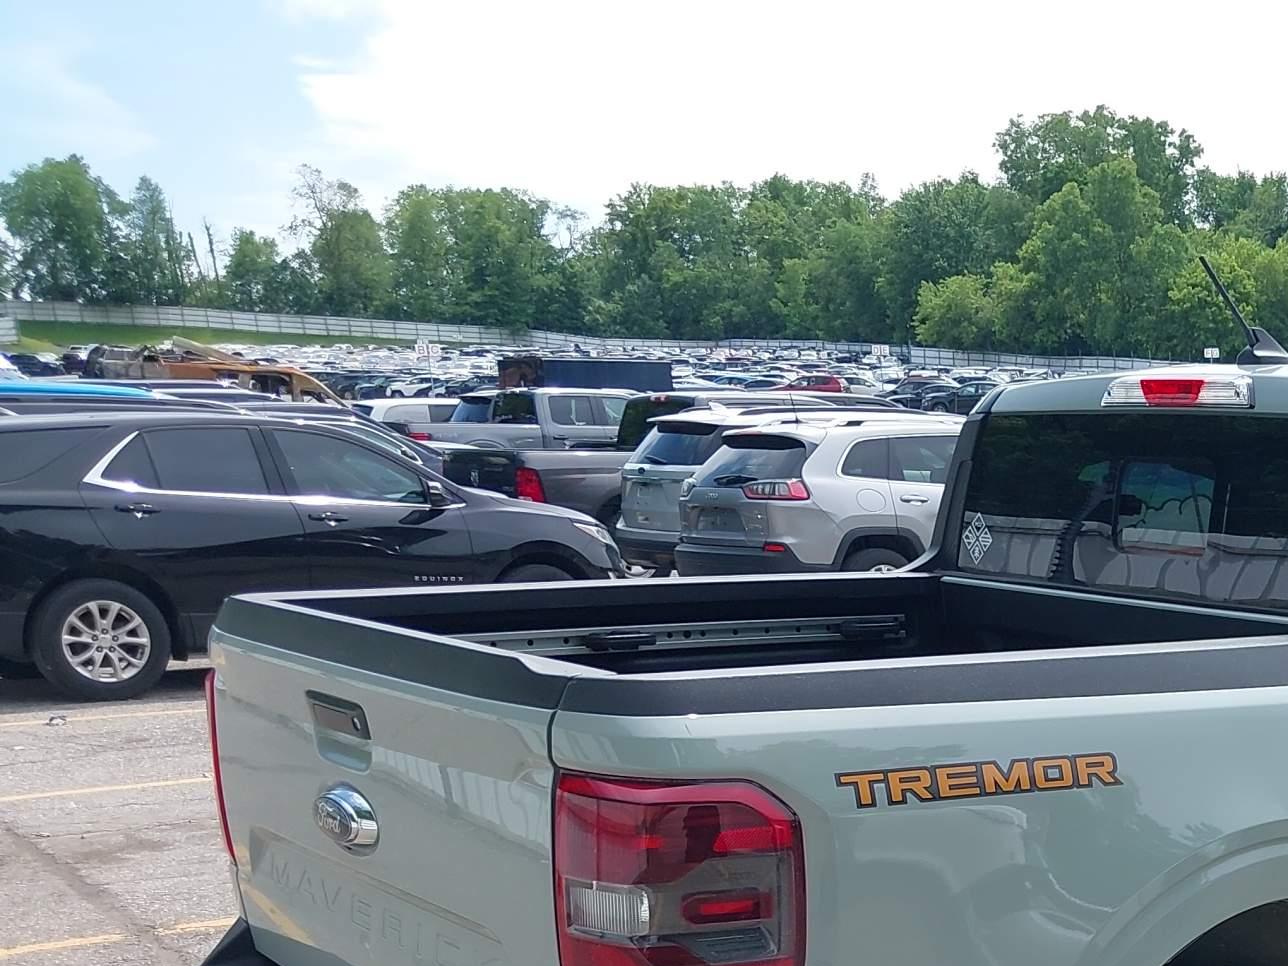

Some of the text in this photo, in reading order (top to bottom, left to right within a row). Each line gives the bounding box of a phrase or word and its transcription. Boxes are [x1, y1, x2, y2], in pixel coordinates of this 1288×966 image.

[417, 345, 439, 354] B C
[834, 752, 1124, 809] TREMOR
[318, 802, 341, 833] Ford
